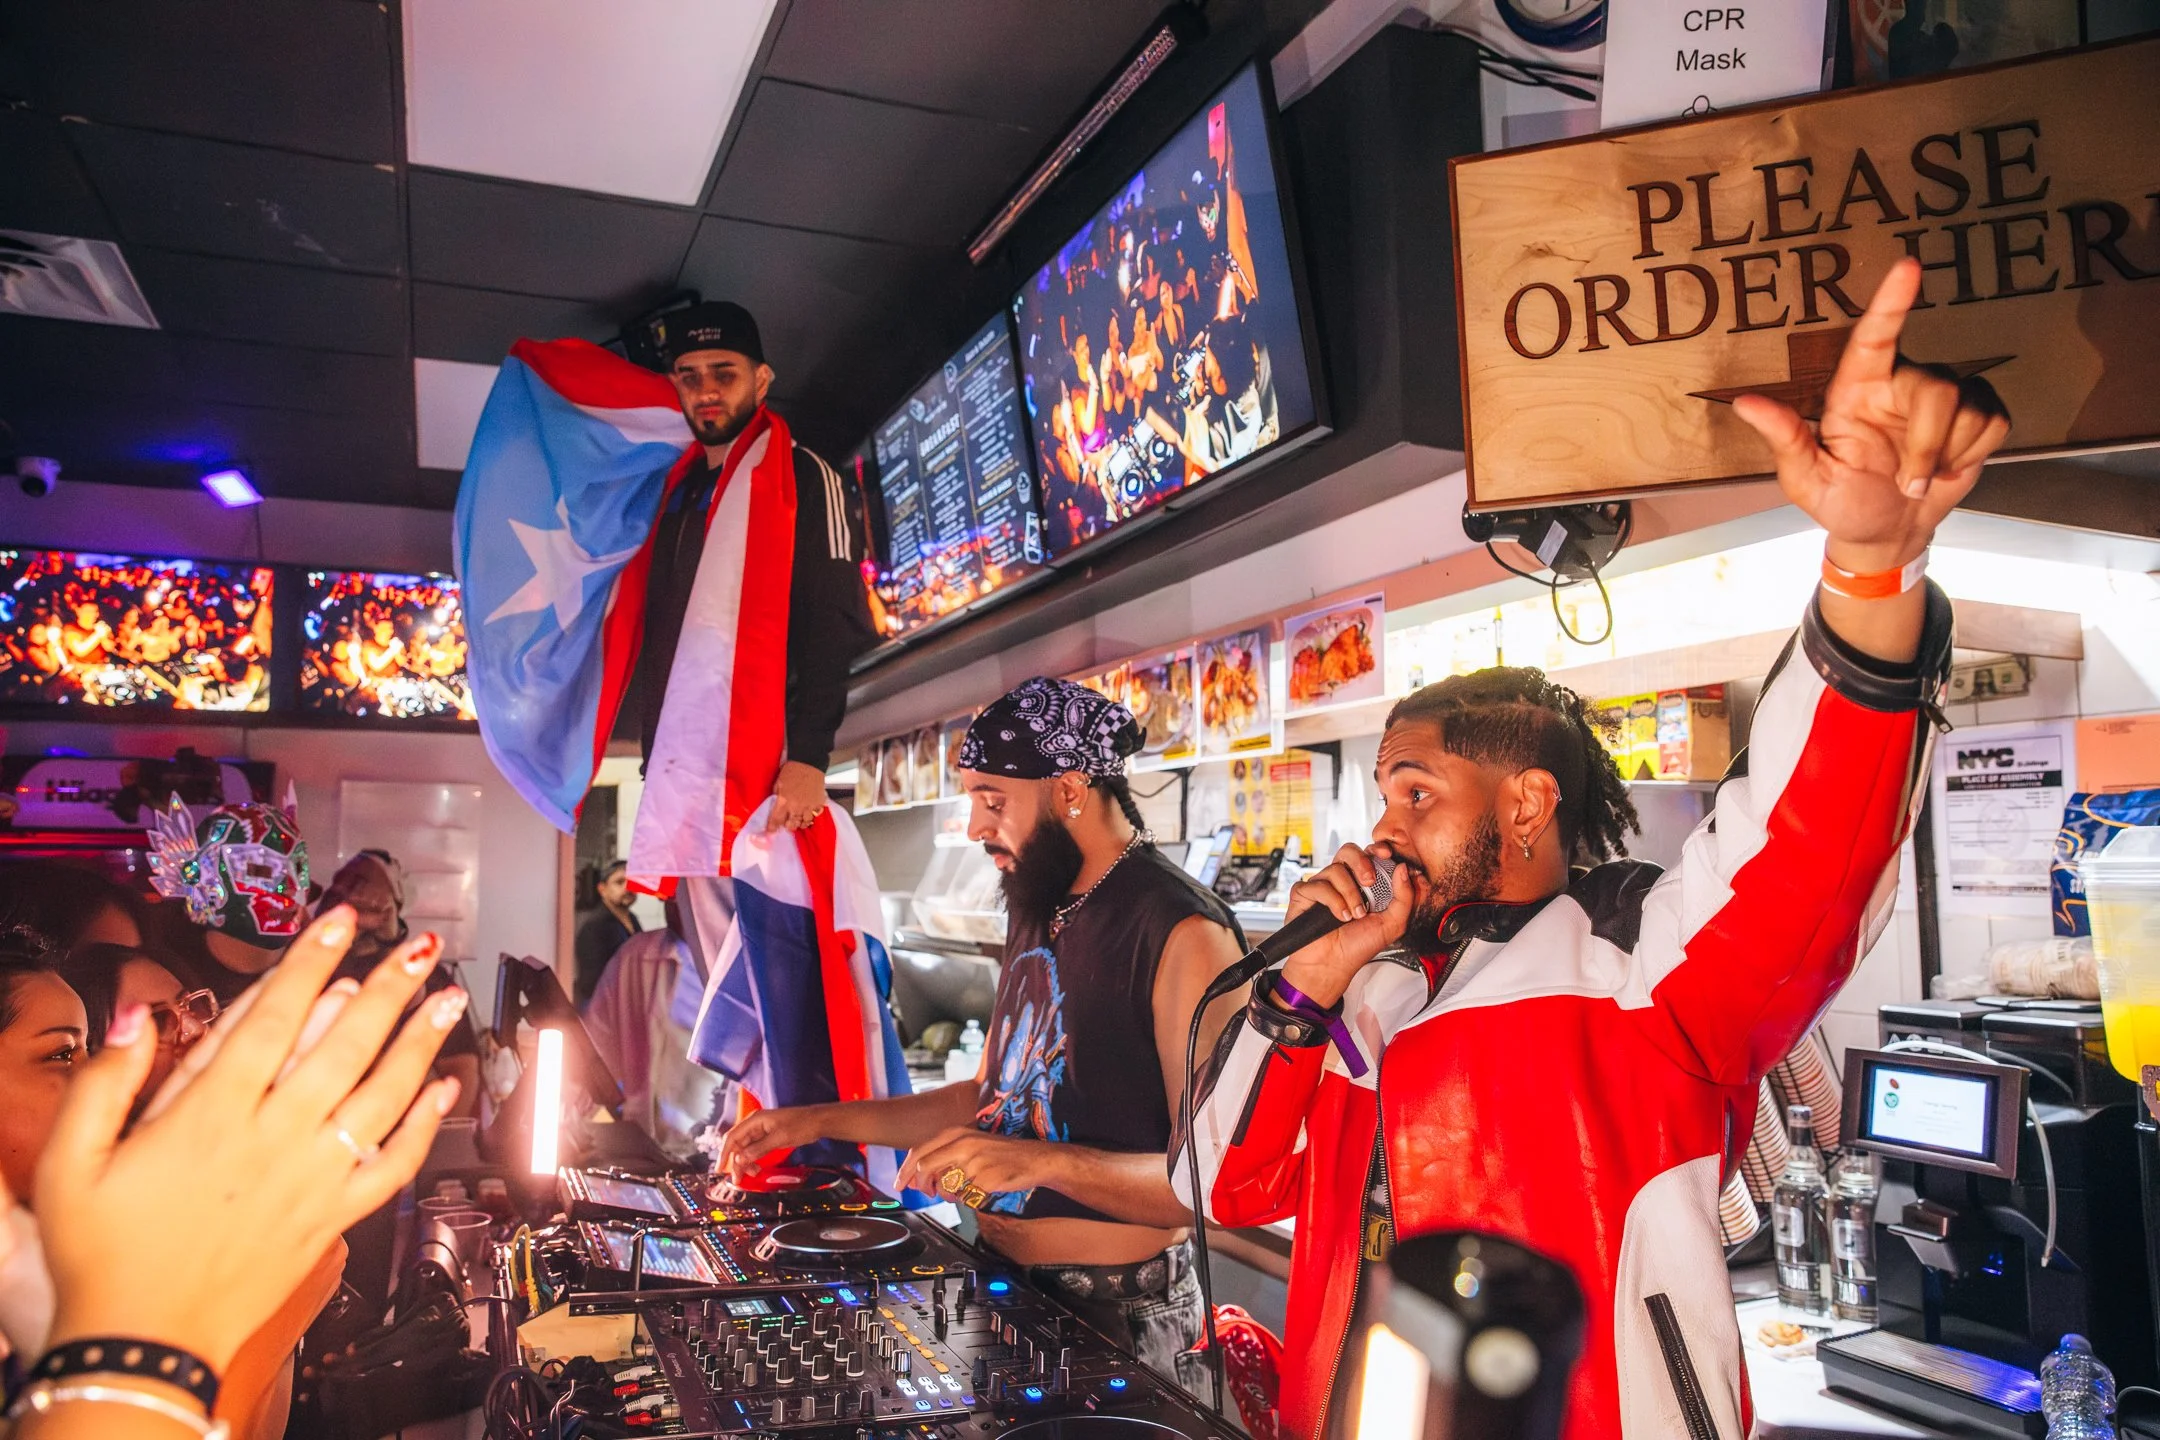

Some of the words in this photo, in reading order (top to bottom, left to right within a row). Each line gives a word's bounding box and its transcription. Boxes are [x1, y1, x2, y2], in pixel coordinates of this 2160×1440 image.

[1683, 8, 1745, 32] CPR
[1676, 47, 1747, 71] Mask
[1627, 119, 2051, 261] PLEASE
[1503, 242, 1867, 359] ORDER
[1894, 192, 2160, 310] HER
[1958, 748, 2014, 769] NYC
